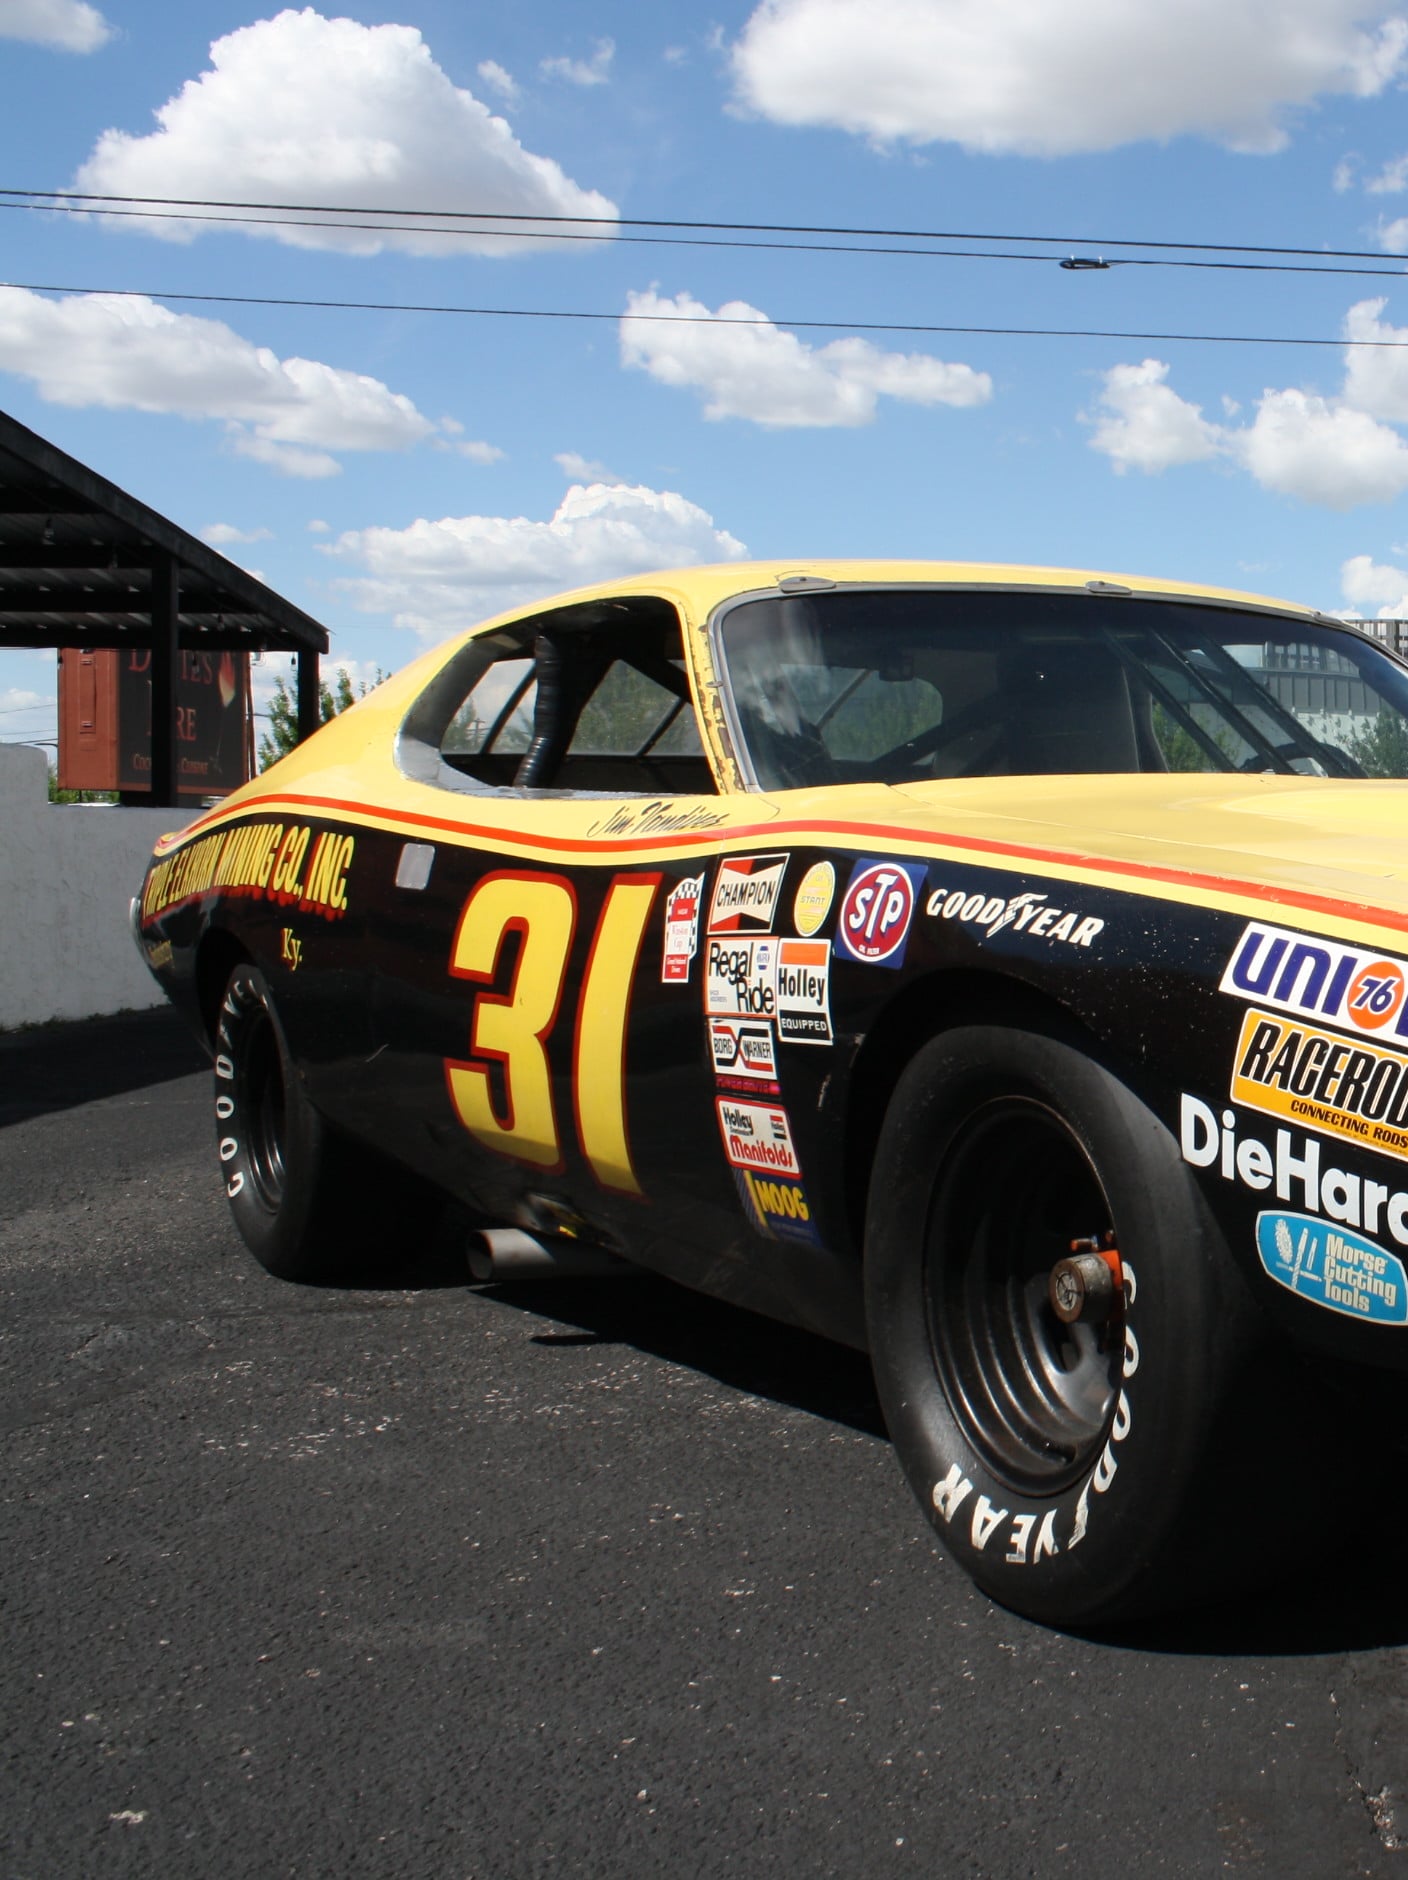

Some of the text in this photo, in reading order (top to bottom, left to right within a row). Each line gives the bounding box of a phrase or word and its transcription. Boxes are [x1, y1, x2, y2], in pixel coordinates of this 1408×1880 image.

[213, 823, 284, 889] MINING
[305, 831, 355, 911] INC.
[716, 879, 777, 908] CHAMPION
[848, 874, 905, 941] STP
[926, 888, 1104, 947] GOODYEAR
[281, 928, 303, 971] Ky.
[709, 942, 754, 985] Regal
[736, 976, 775, 1014] Ride
[778, 967, 826, 1007] Holley
[1350, 975, 1400, 1013] 76
[444, 869, 664, 1204] 31
[781, 1017, 828, 1033] EQUIPPED
[713, 1038, 773, 1059] BORG WARNER
[723, 1106, 754, 1136] Holley
[1290, 1100, 1370, 1137] CONNECTING
[1372, 1126, 1408, 1149] RODS
[729, 1134, 793, 1168] Manifolds
[754, 1179, 809, 1221] MOOG
[1326, 1233, 1386, 1275] Morse
[1324, 1256, 1397, 1307] Cutting
[1324, 1276, 1370, 1313] Tools
